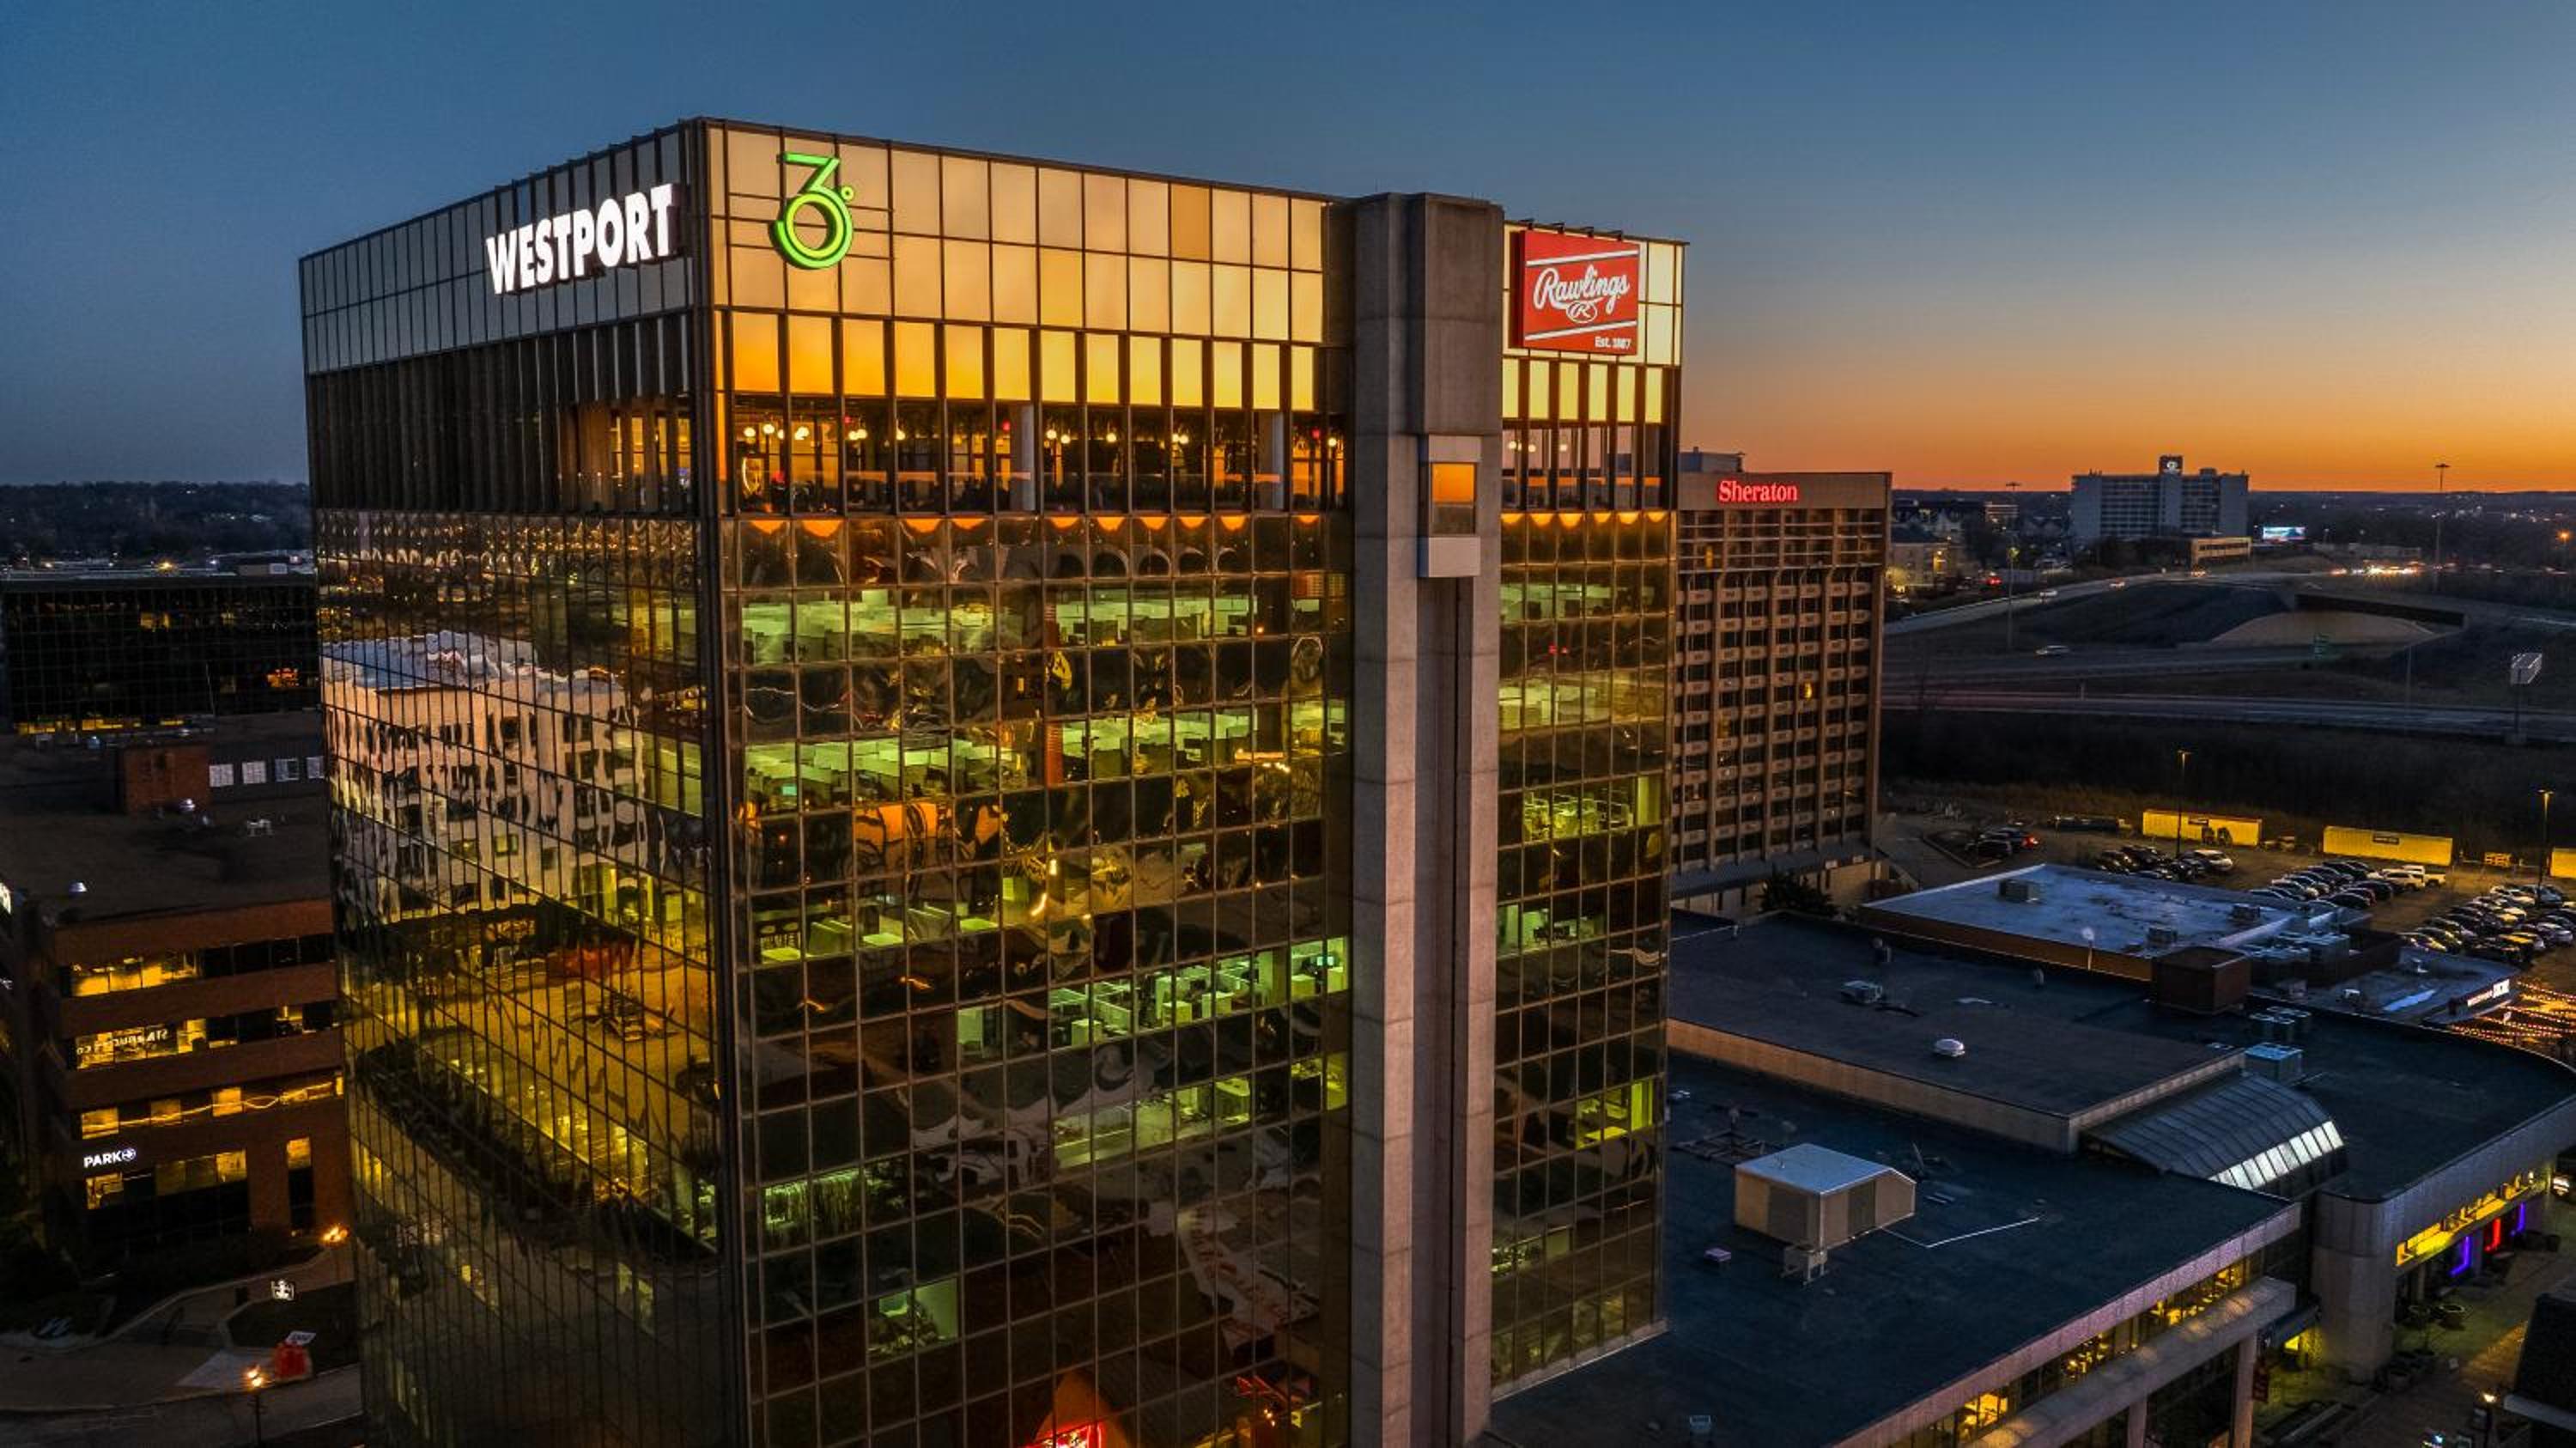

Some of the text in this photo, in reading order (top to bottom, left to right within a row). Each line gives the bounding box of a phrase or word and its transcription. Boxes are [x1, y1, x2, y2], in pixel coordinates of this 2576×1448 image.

[484, 182, 673, 295] WESTPORT
[1533, 264, 1631, 315] Rawlings
[1718, 479, 1798, 503] Sheraton
[83, 1149, 123, 1169] PARK
